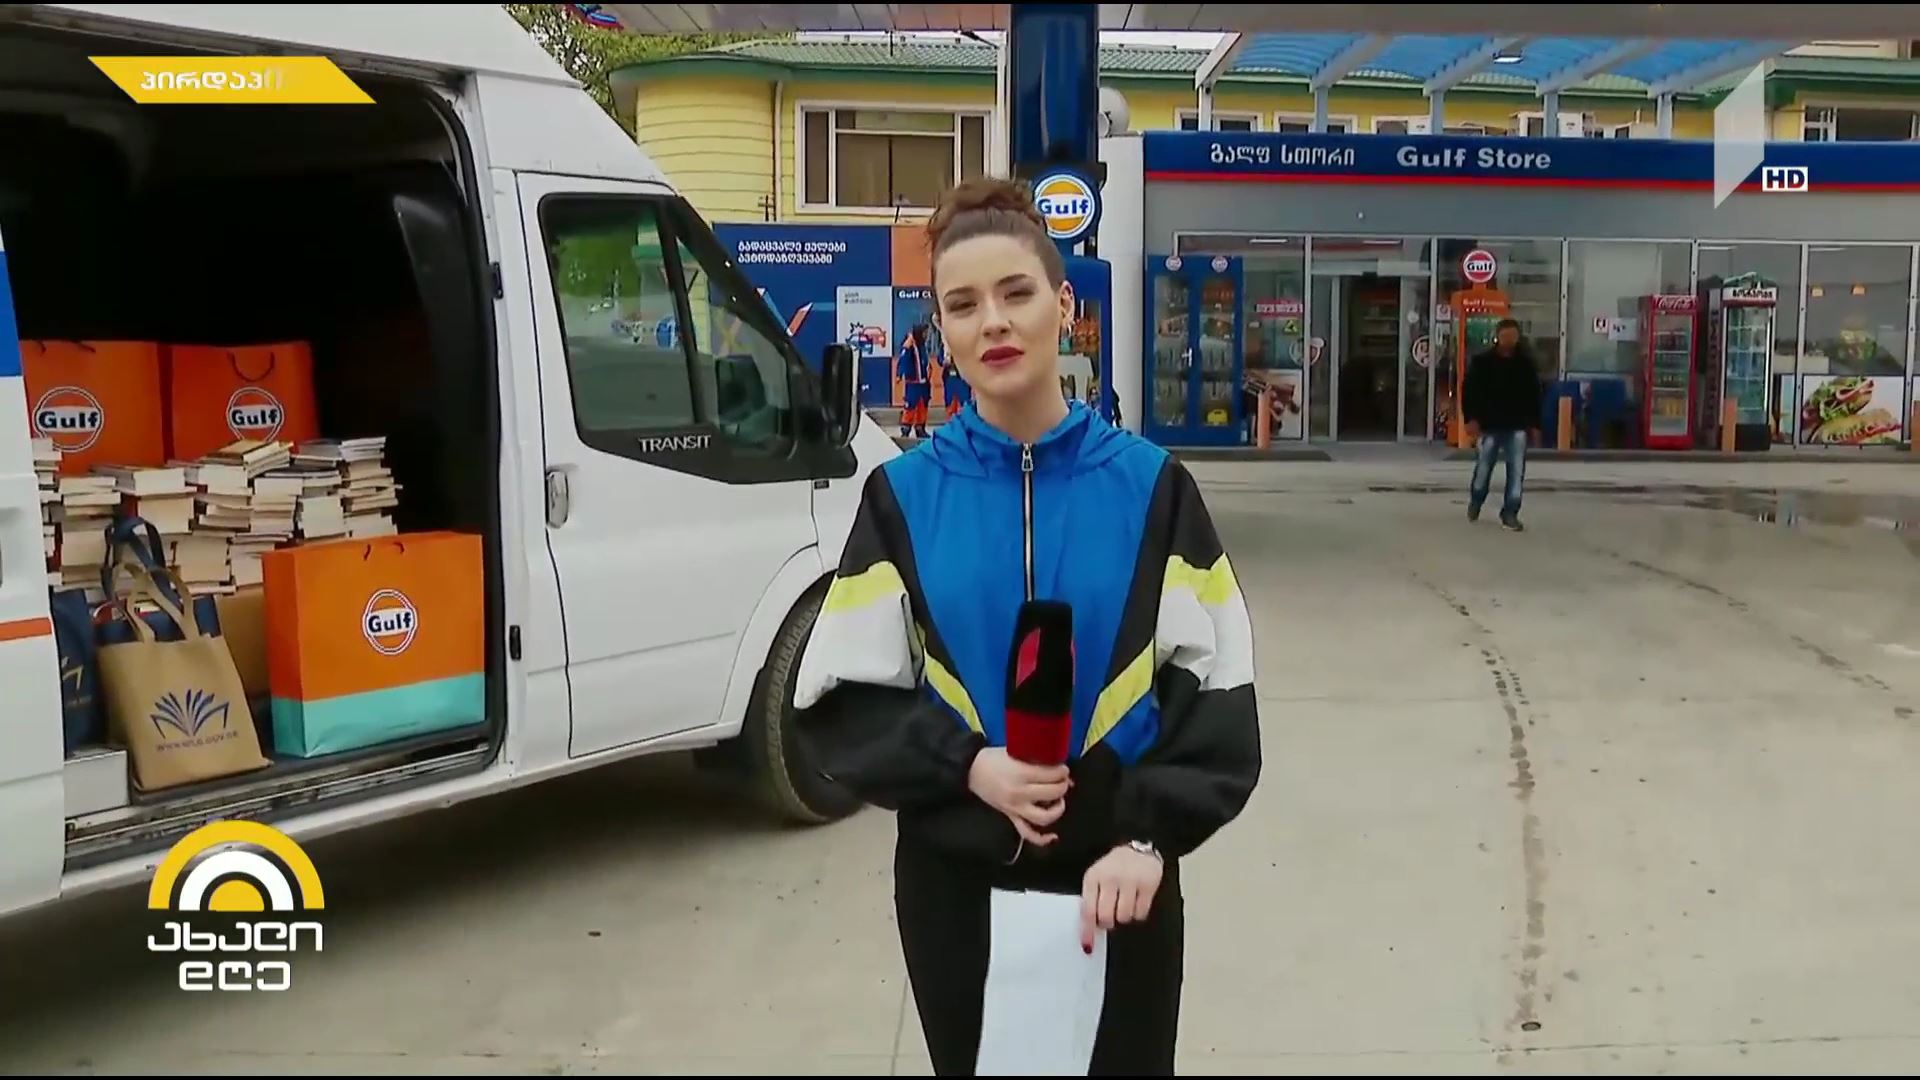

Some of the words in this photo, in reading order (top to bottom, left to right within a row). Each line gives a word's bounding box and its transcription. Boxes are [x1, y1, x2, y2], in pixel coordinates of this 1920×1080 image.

[1210, 143, 1271, 164] გალფ
[1281, 145, 1355, 166] სთორი
[1397, 146, 1467, 167] Gulf
[1477, 147, 1552, 169] Store
[1038, 199, 1089, 214] Gulf
[1466, 262, 1493, 271] Gulf
[899, 290, 920, 299] Gulf
[38, 411, 100, 429] Gulf
[231, 407, 279, 426] Gulf
[639, 435, 711, 452] TRANSIT
[368, 612, 412, 633] Gulf
